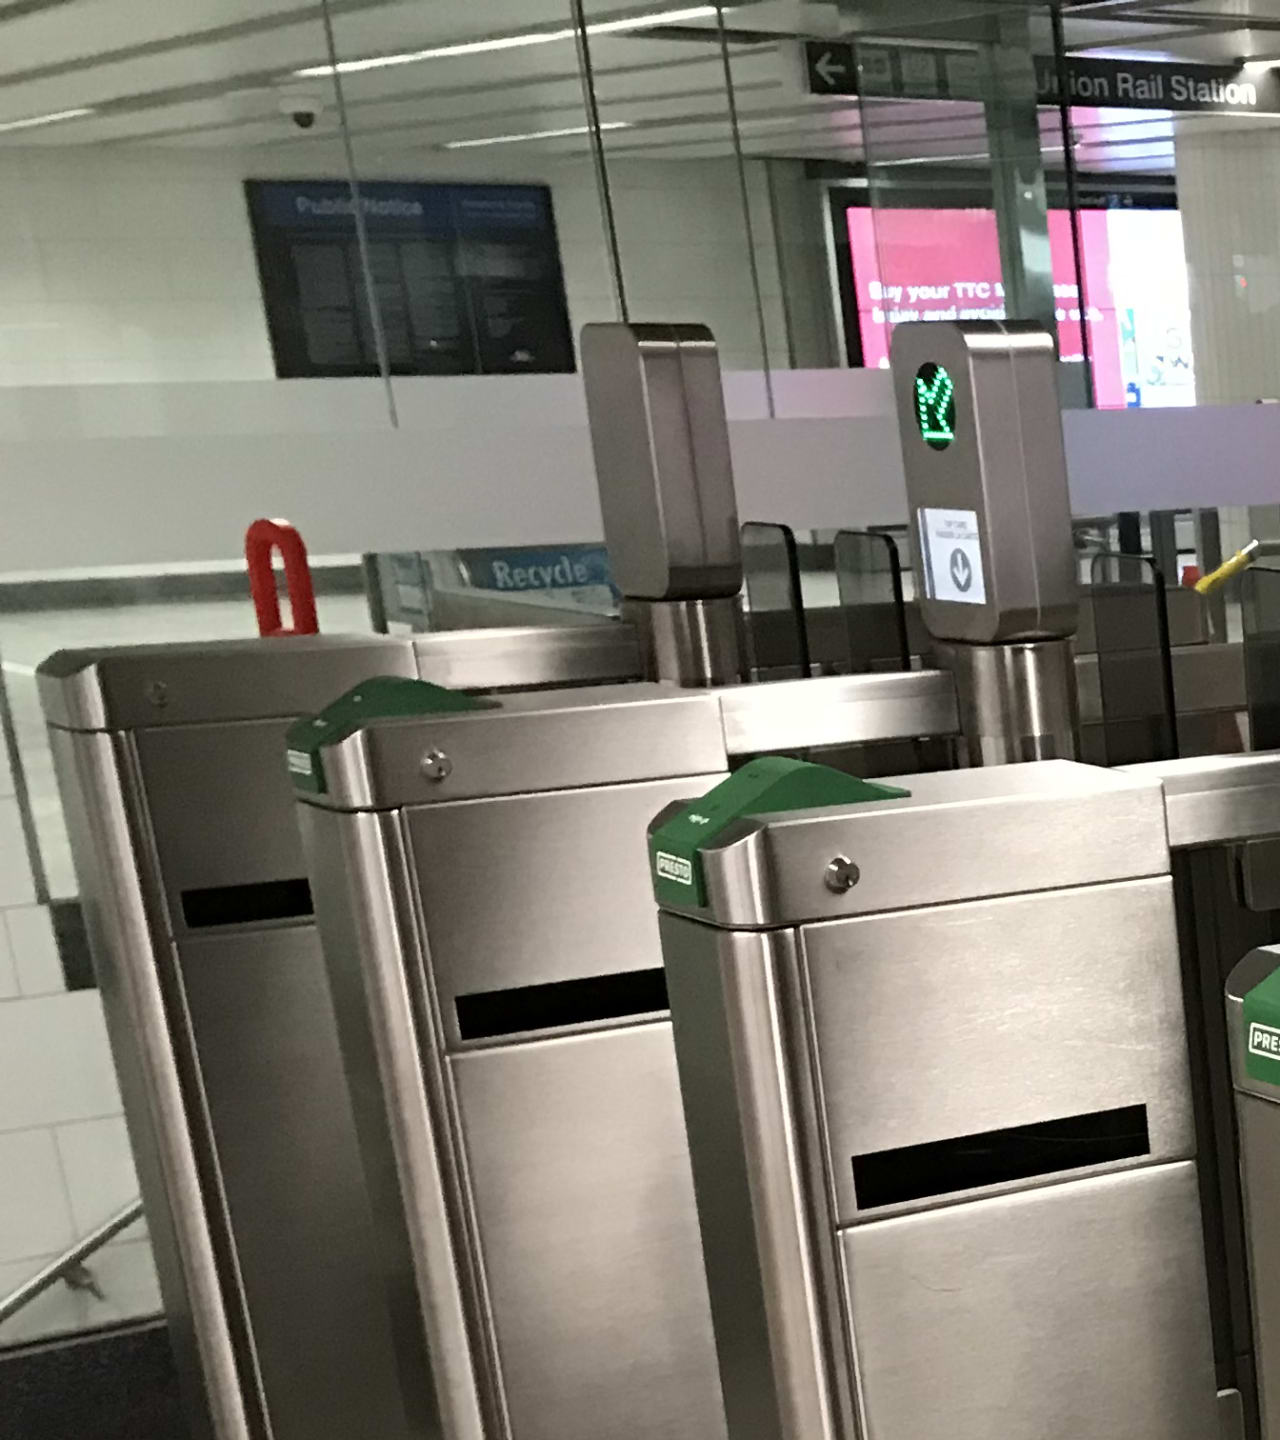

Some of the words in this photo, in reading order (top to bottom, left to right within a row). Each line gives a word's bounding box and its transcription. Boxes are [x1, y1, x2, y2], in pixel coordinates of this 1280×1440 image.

[1116, 72, 1164, 99] Rail
[1170, 75, 1257, 106] Station
[906, 285, 951, 304] your
[952, 281, 992, 299] TTC
[491, 554, 589, 591] Recycle
